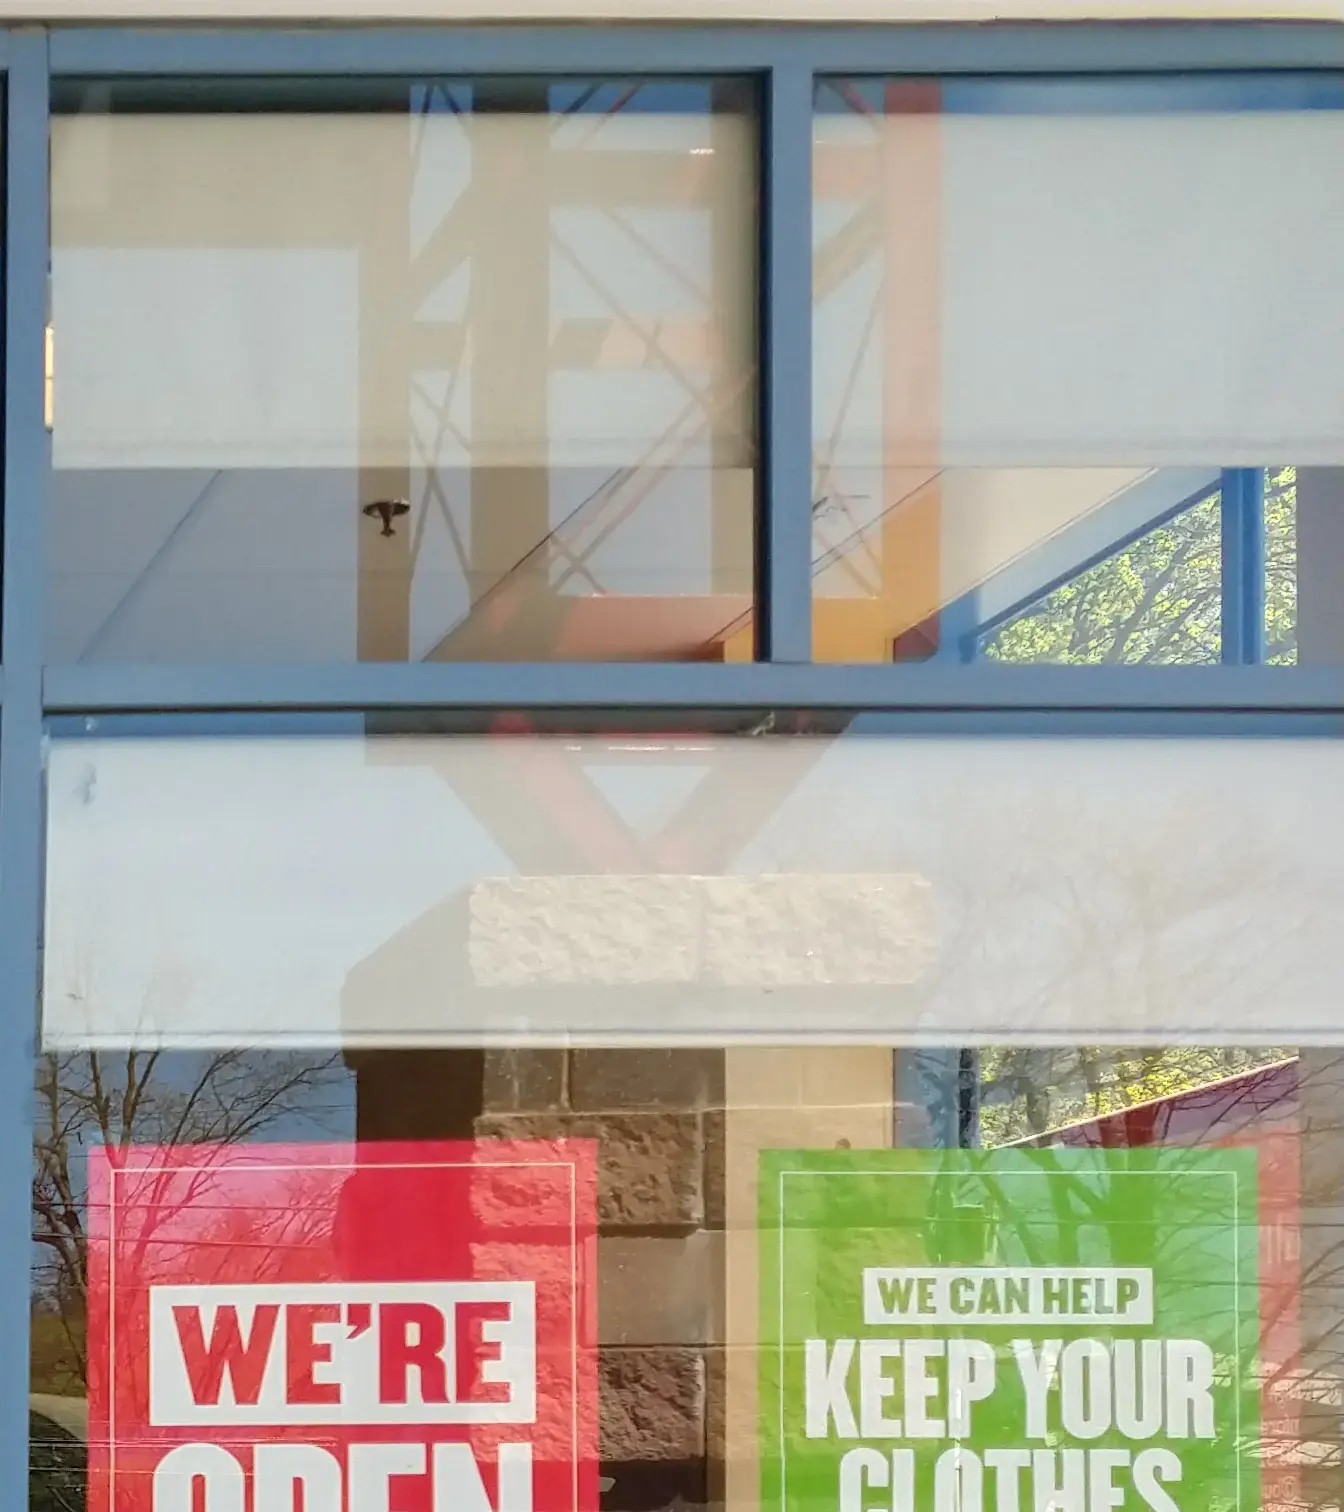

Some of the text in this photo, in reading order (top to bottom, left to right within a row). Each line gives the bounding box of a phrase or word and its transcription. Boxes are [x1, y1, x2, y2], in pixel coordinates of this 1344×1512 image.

[877, 1277, 1140, 1315] WE CAN HELP
[171, 1301, 512, 1406] WE'RE
[803, 1338, 1217, 1440] KEEP YOUR
